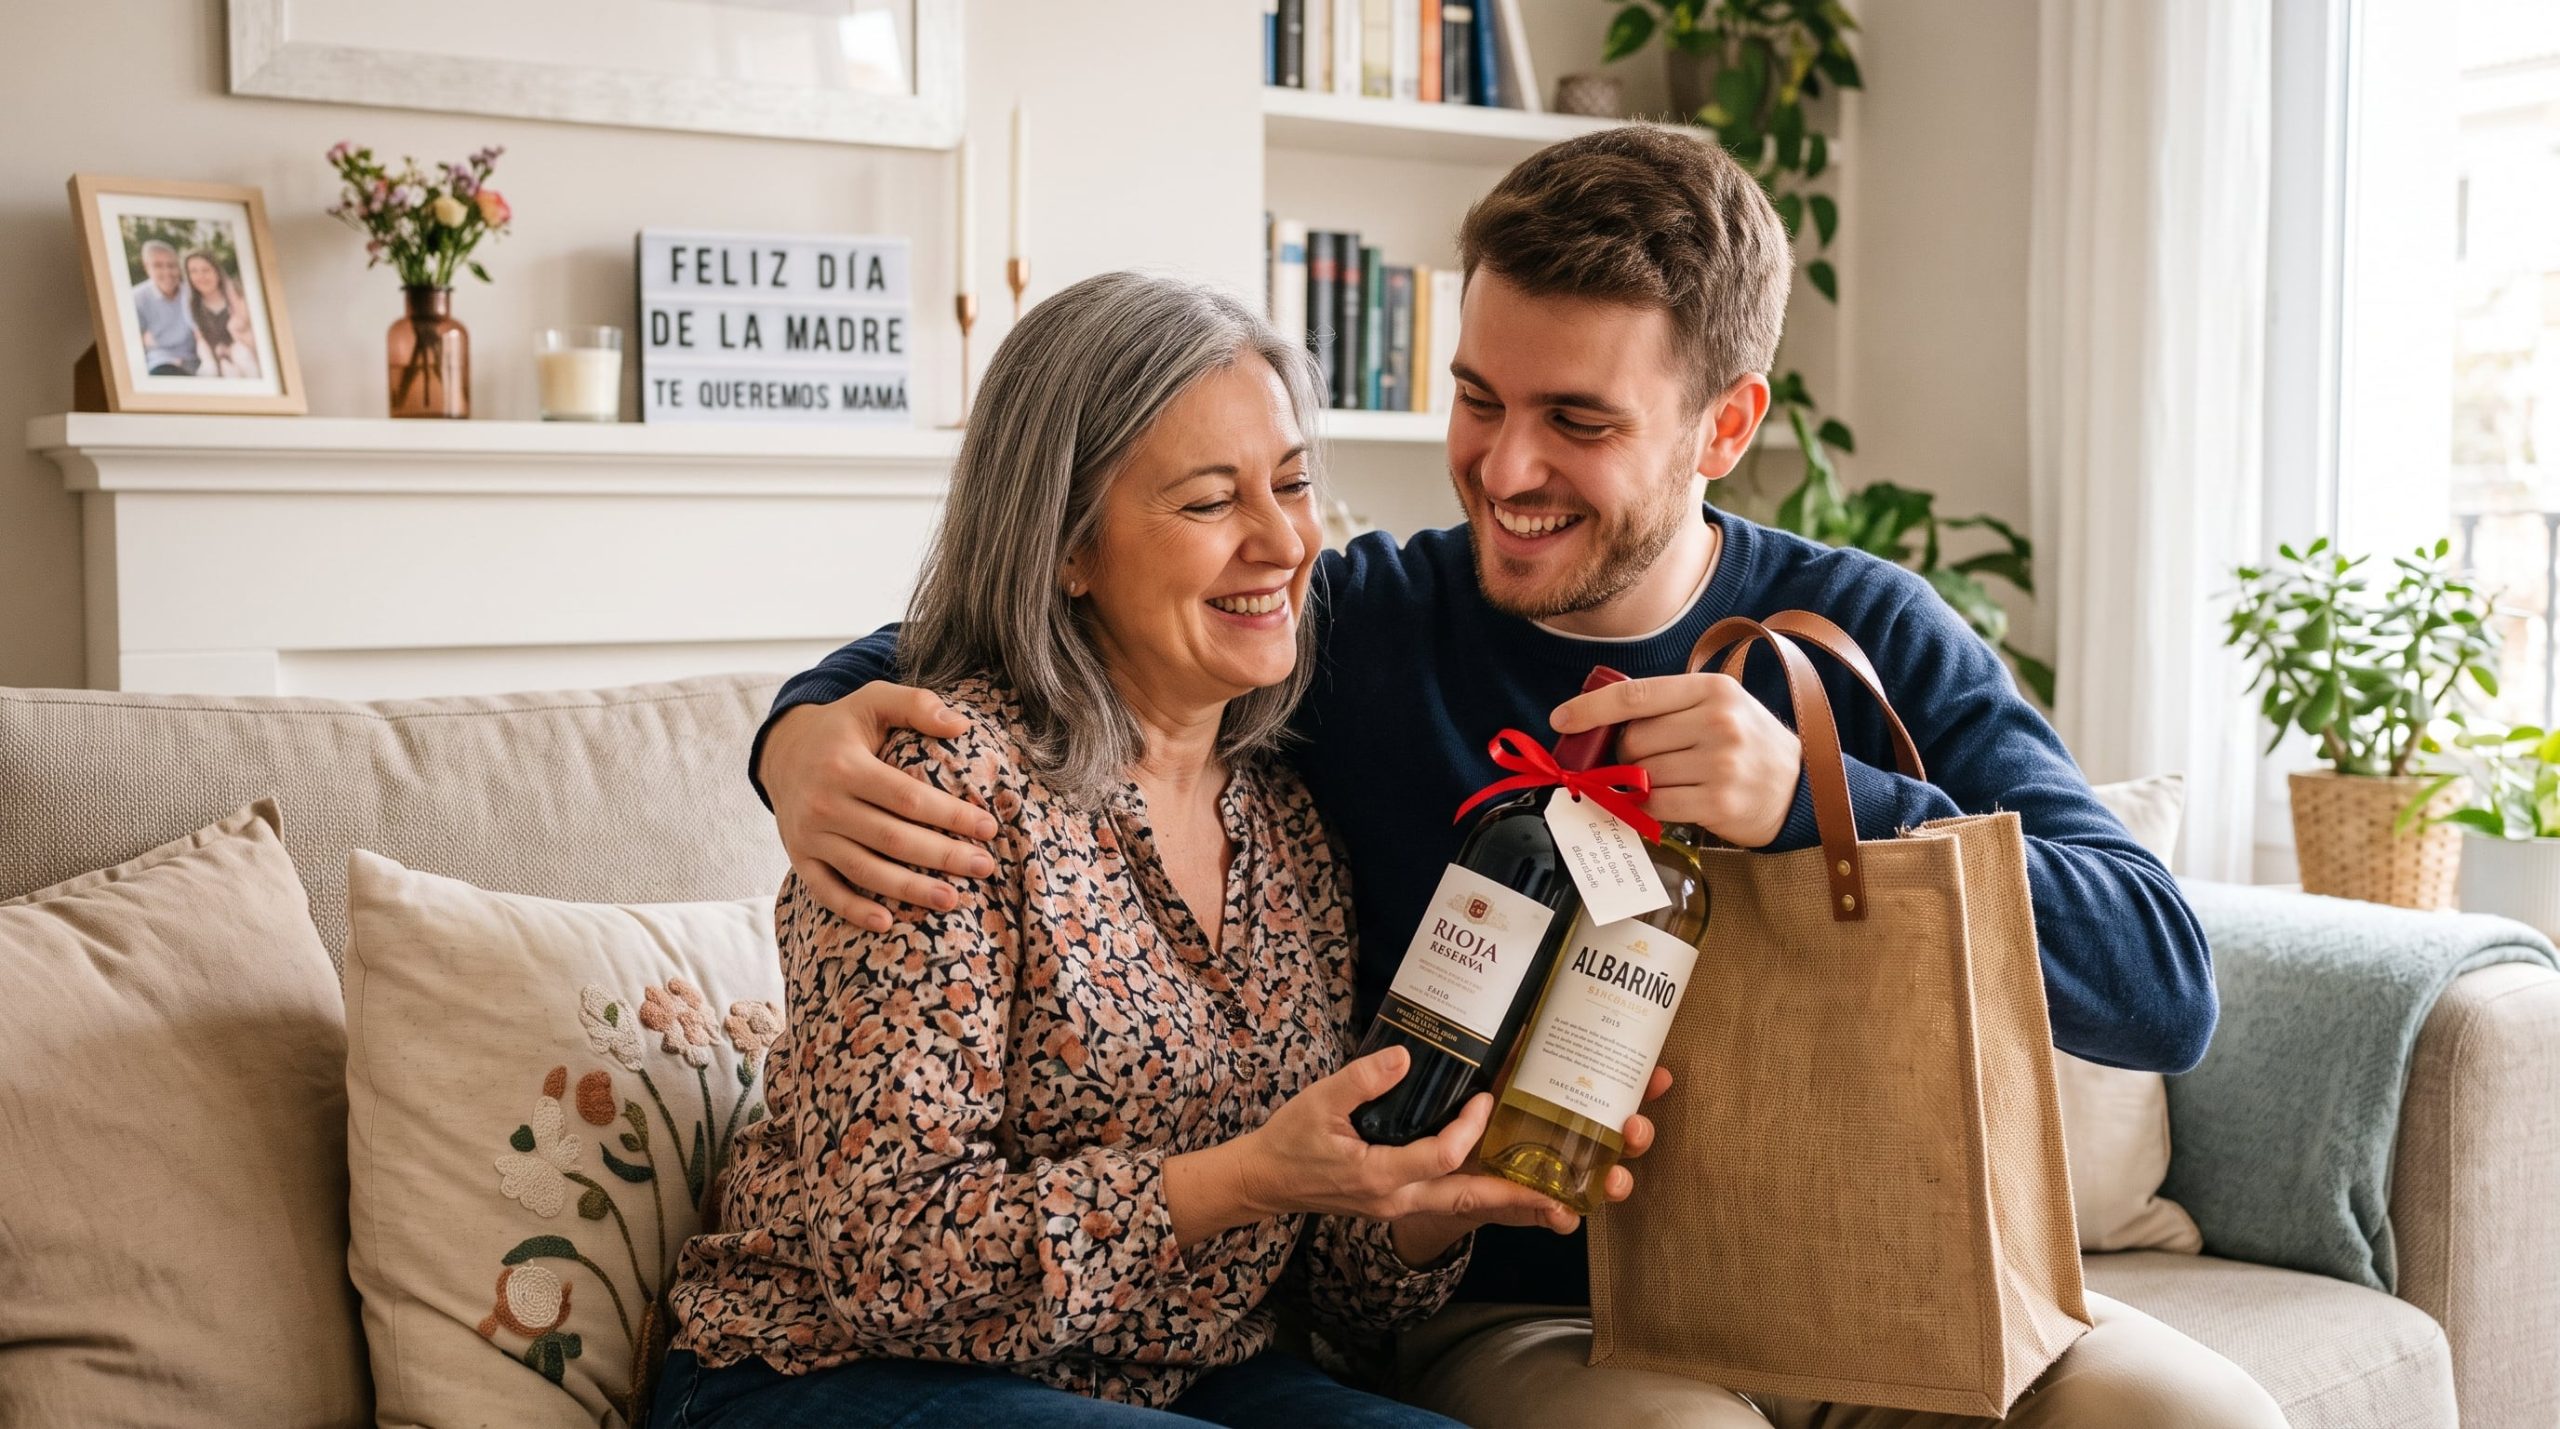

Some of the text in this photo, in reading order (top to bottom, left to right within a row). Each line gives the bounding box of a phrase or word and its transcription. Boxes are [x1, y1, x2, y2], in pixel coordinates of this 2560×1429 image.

[670, 246, 886, 291] FELIZ DÍA
[651, 310, 904, 354] DE LA MADRE
[653, 378, 909, 411] TE QUEREMOS MAMÁ
[1429, 940, 1483, 973] RESERVA
[1432, 917, 1497, 963] RIOJA
[1571, 946, 1676, 1009] ALBARIÑO
